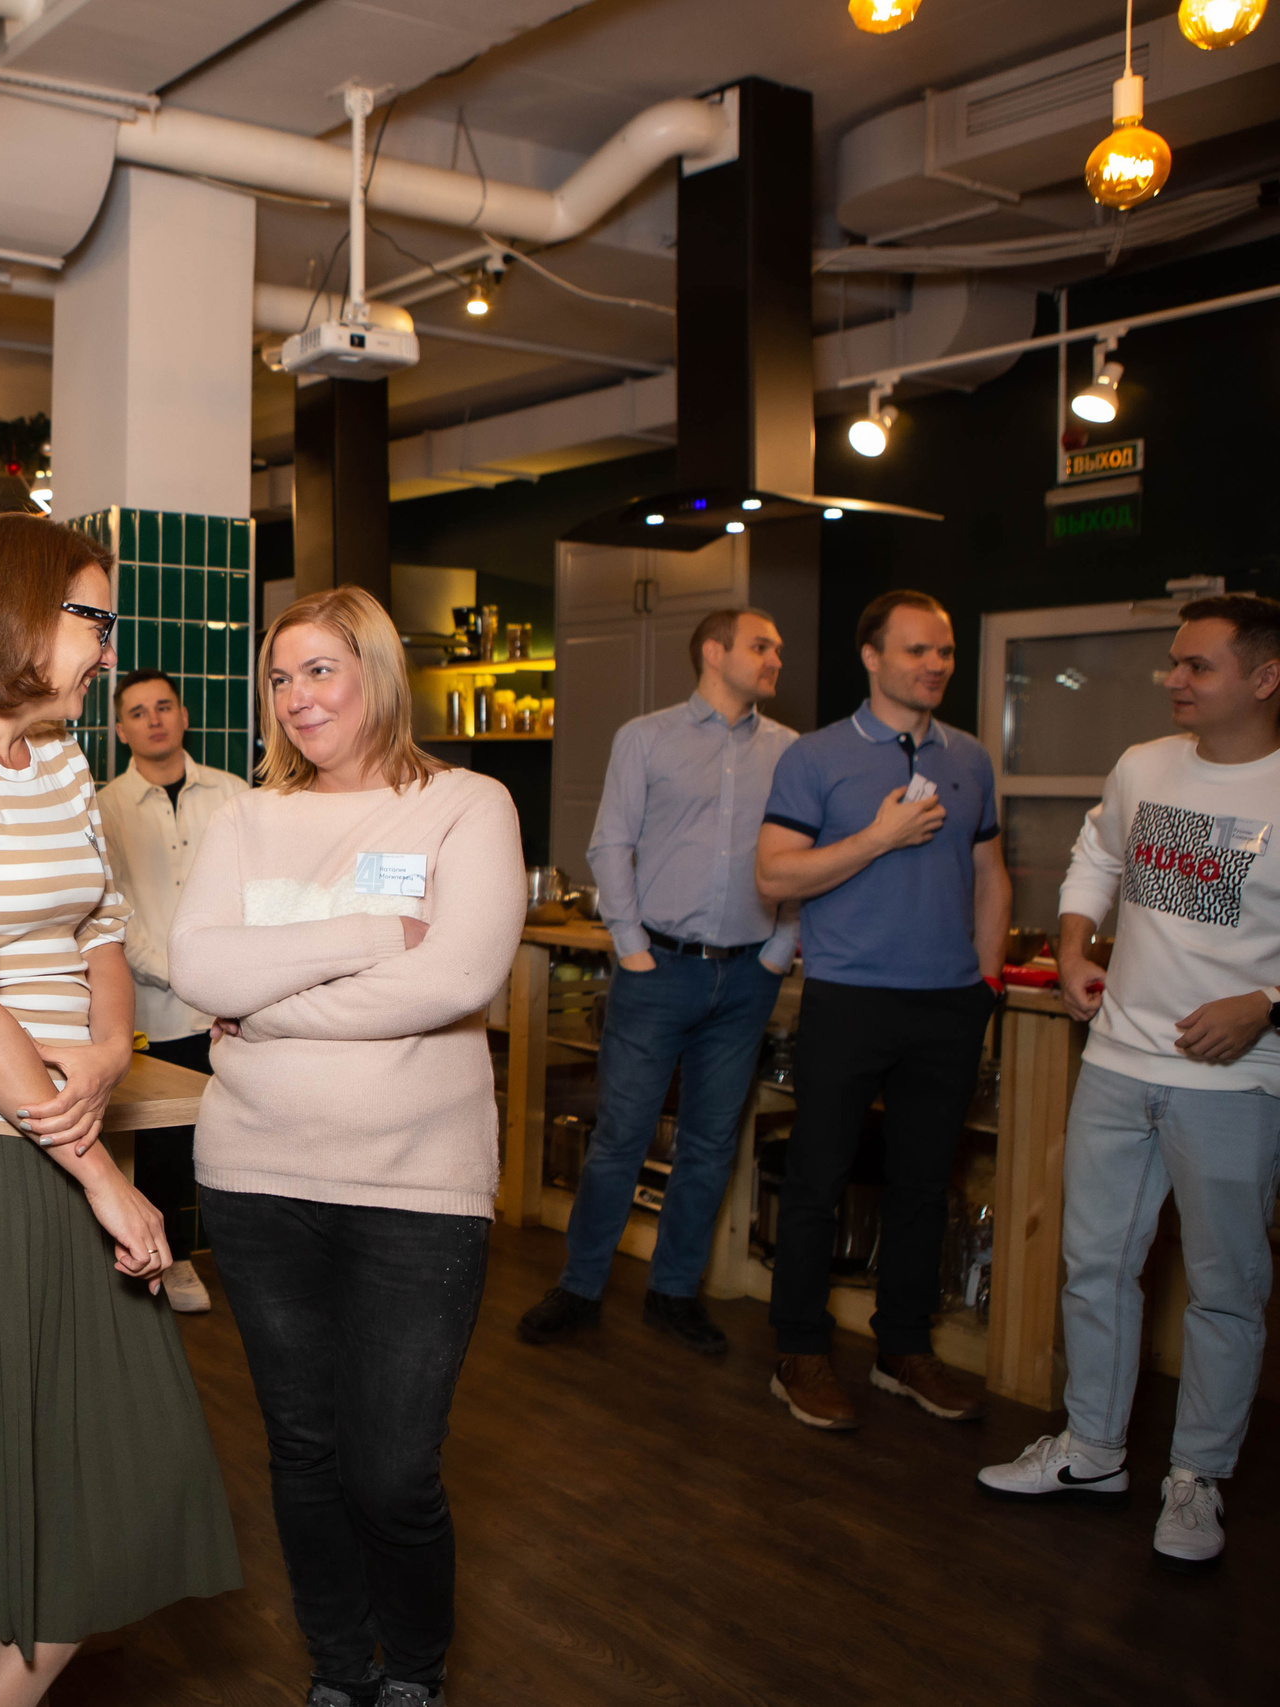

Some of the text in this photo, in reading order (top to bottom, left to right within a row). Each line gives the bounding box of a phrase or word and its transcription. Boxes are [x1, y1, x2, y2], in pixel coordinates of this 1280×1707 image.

[1054, 505, 1133, 538] ВЫХОД
[355, 853, 385, 893] 4
[1134, 842, 1221, 882] HUGO
